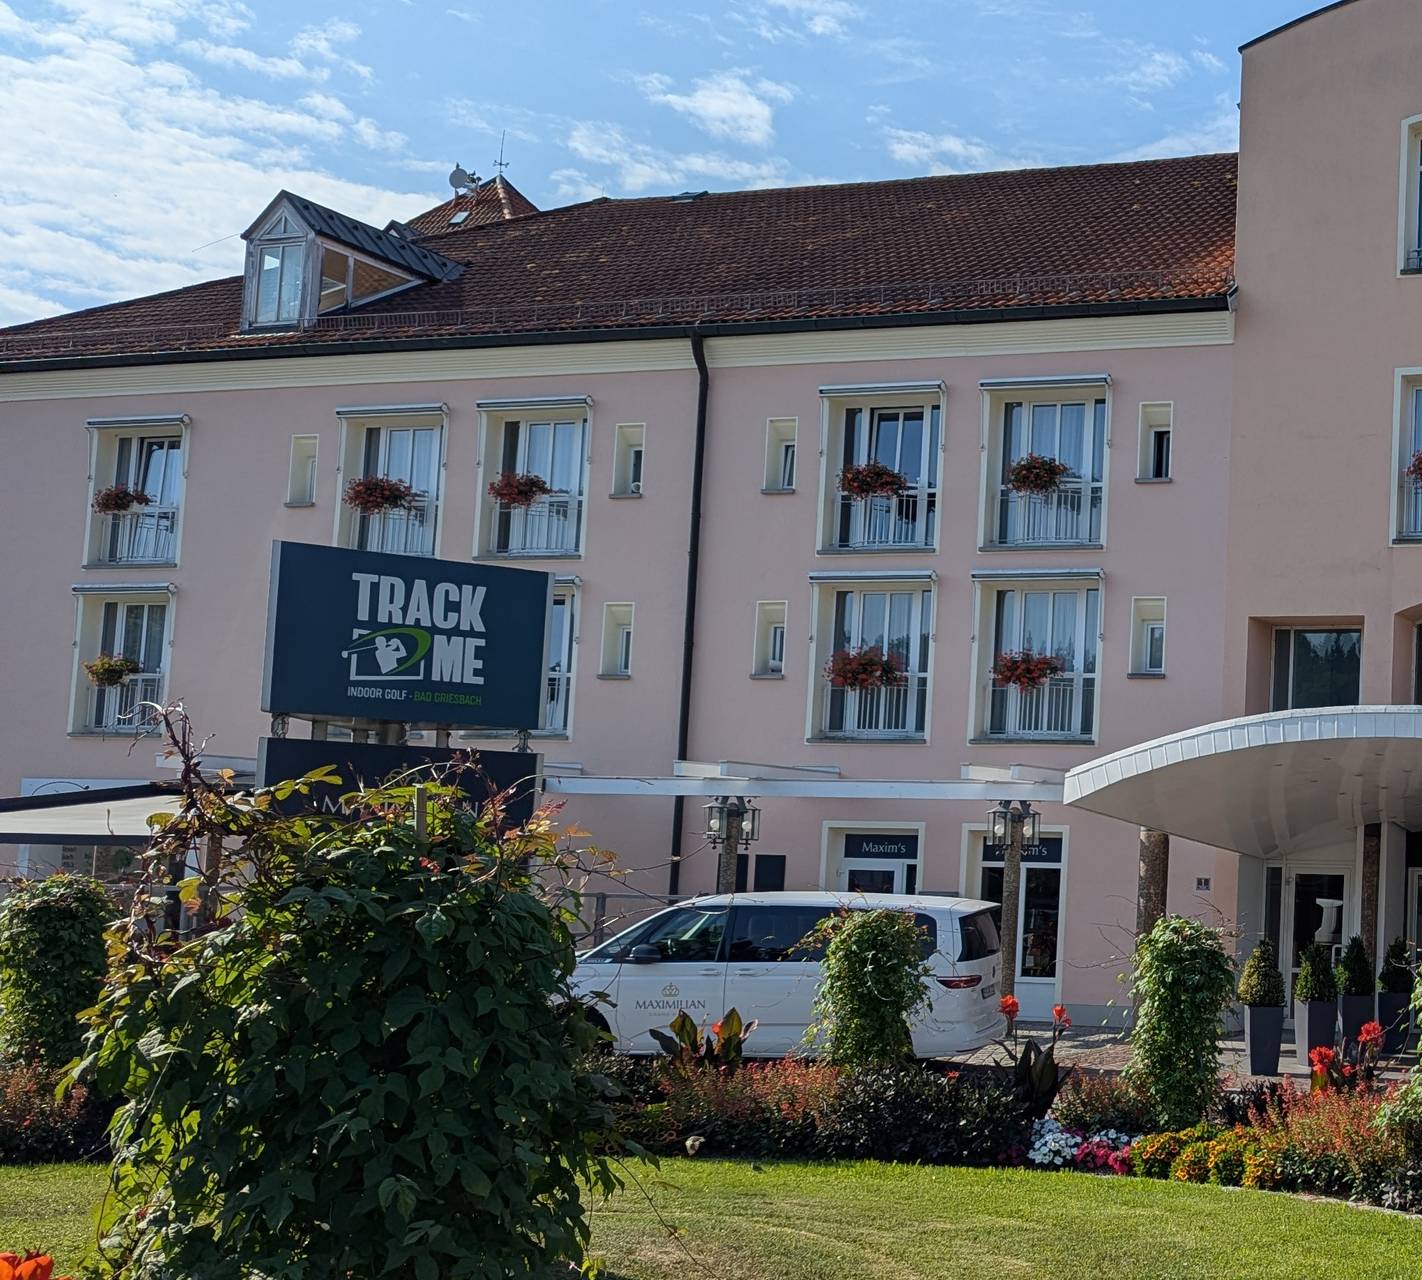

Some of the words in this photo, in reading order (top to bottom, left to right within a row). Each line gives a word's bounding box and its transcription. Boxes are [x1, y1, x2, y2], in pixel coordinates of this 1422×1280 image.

[352, 573, 487, 632] TRACK
[431, 635, 486, 685] ME
[347, 686, 382, 699] INDOOR
[385, 689, 407, 700] GOLF
[414, 691, 431, 701] BAD
[434, 693, 482, 705] GRIESBACH
[862, 842, 906, 853] Maxim's
[635, 1000, 706, 1010] MAXIMILIAN
